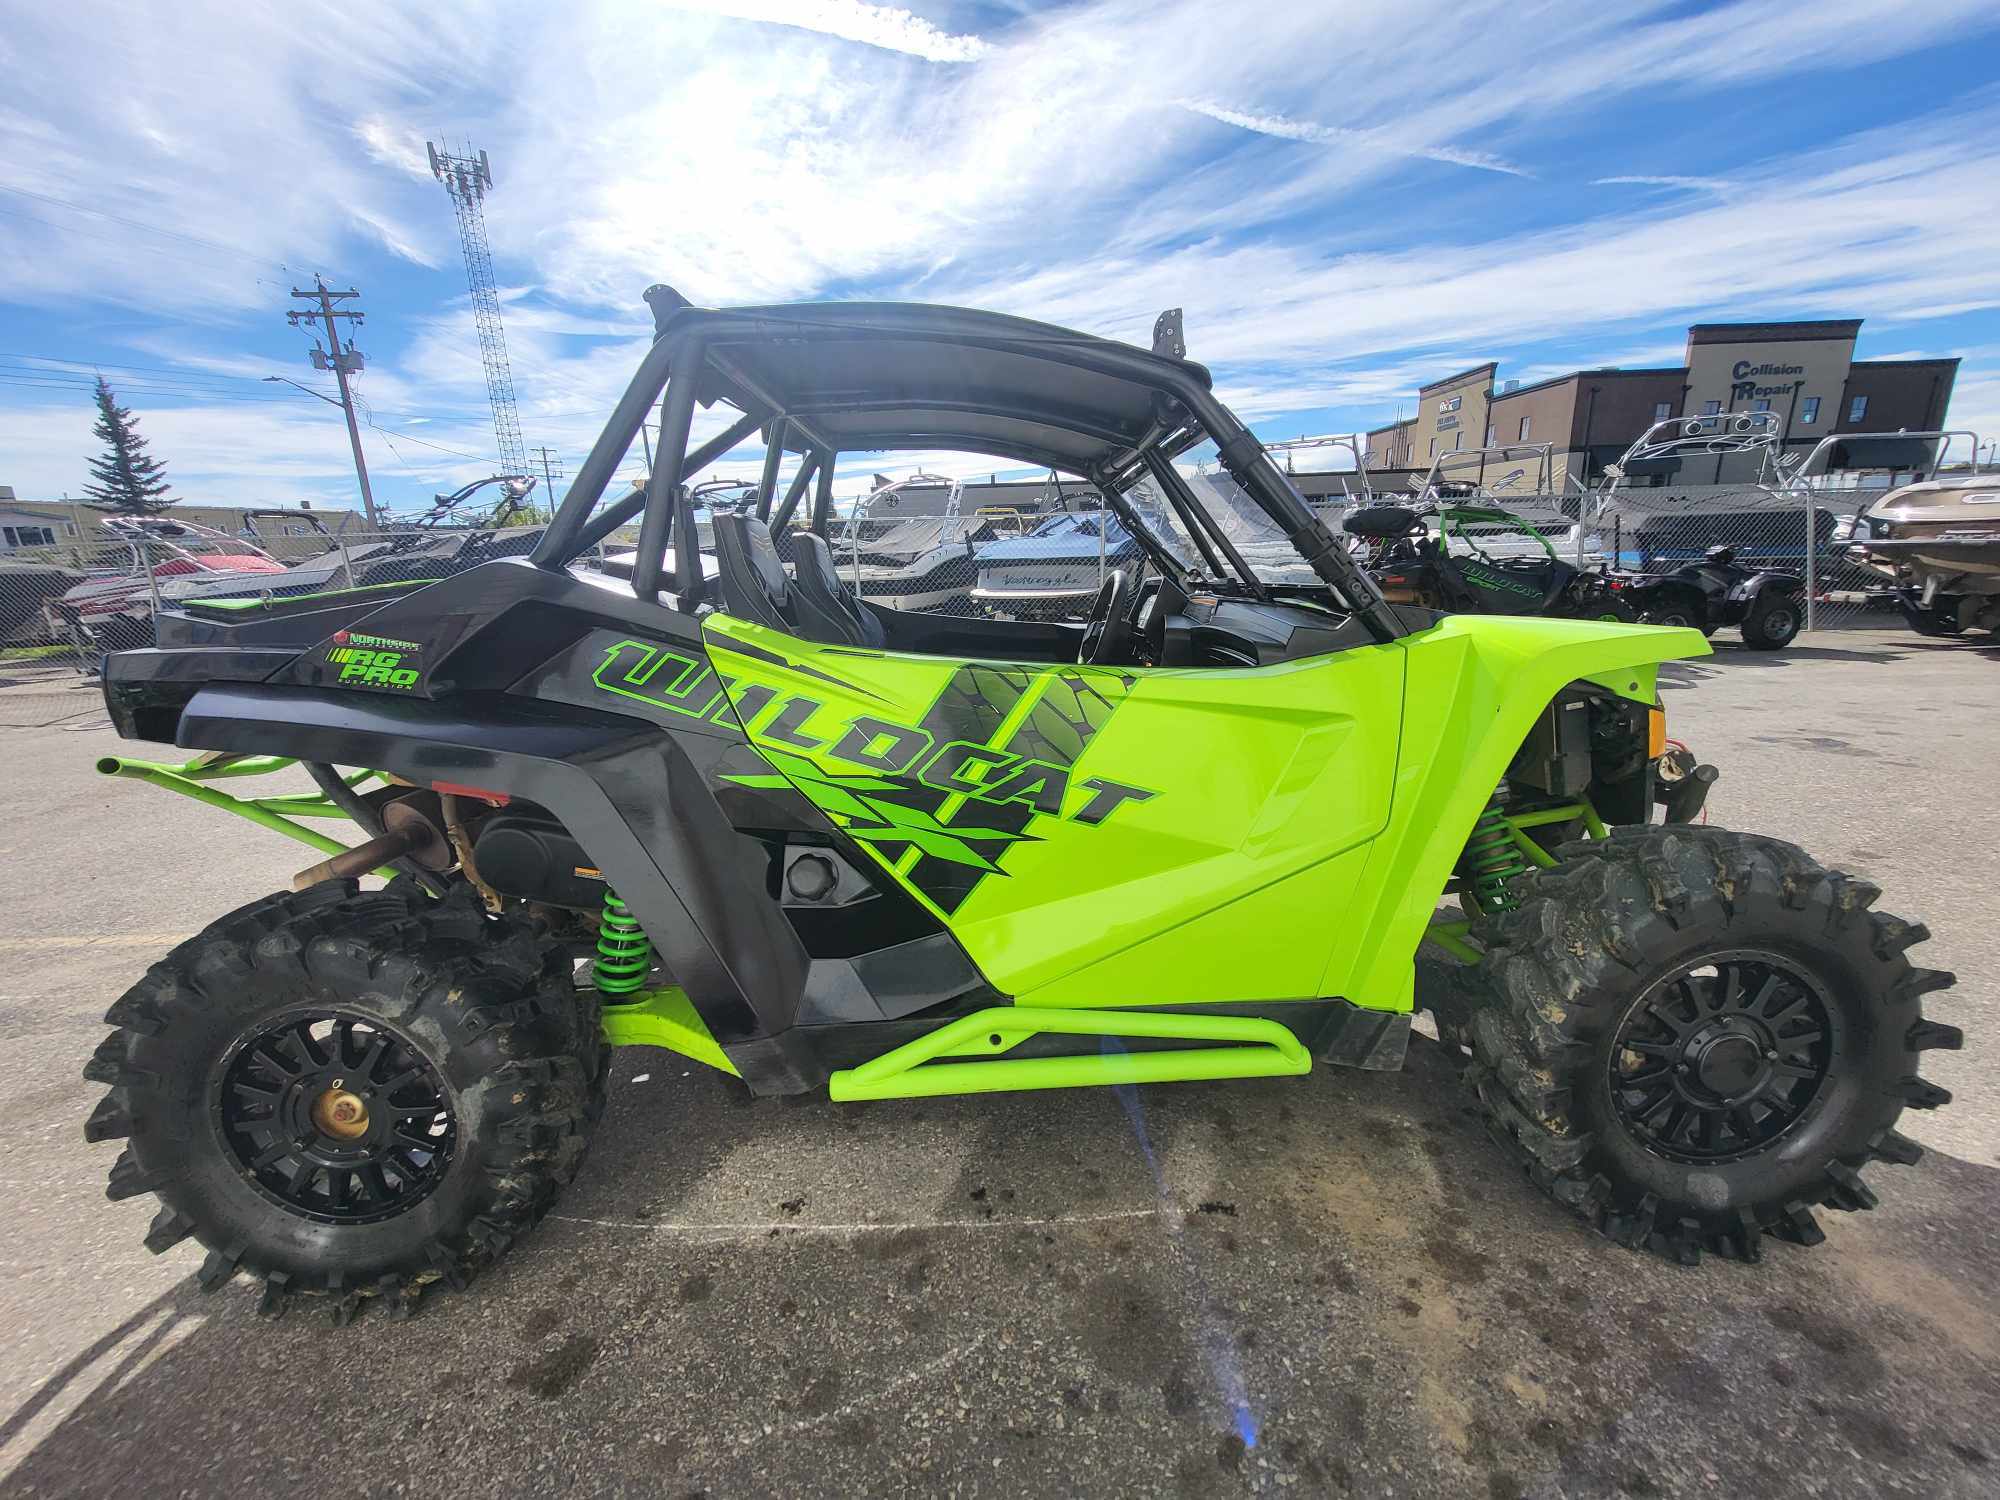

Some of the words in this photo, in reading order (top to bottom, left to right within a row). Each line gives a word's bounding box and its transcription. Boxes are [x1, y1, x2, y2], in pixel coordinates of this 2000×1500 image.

[1732, 360, 1804, 380] Collision
[1737, 381, 1794, 401] Repair
[347, 648, 402, 668] RG
[340, 663, 420, 685] PRO
[592, 640, 1166, 828] WILDCAT
